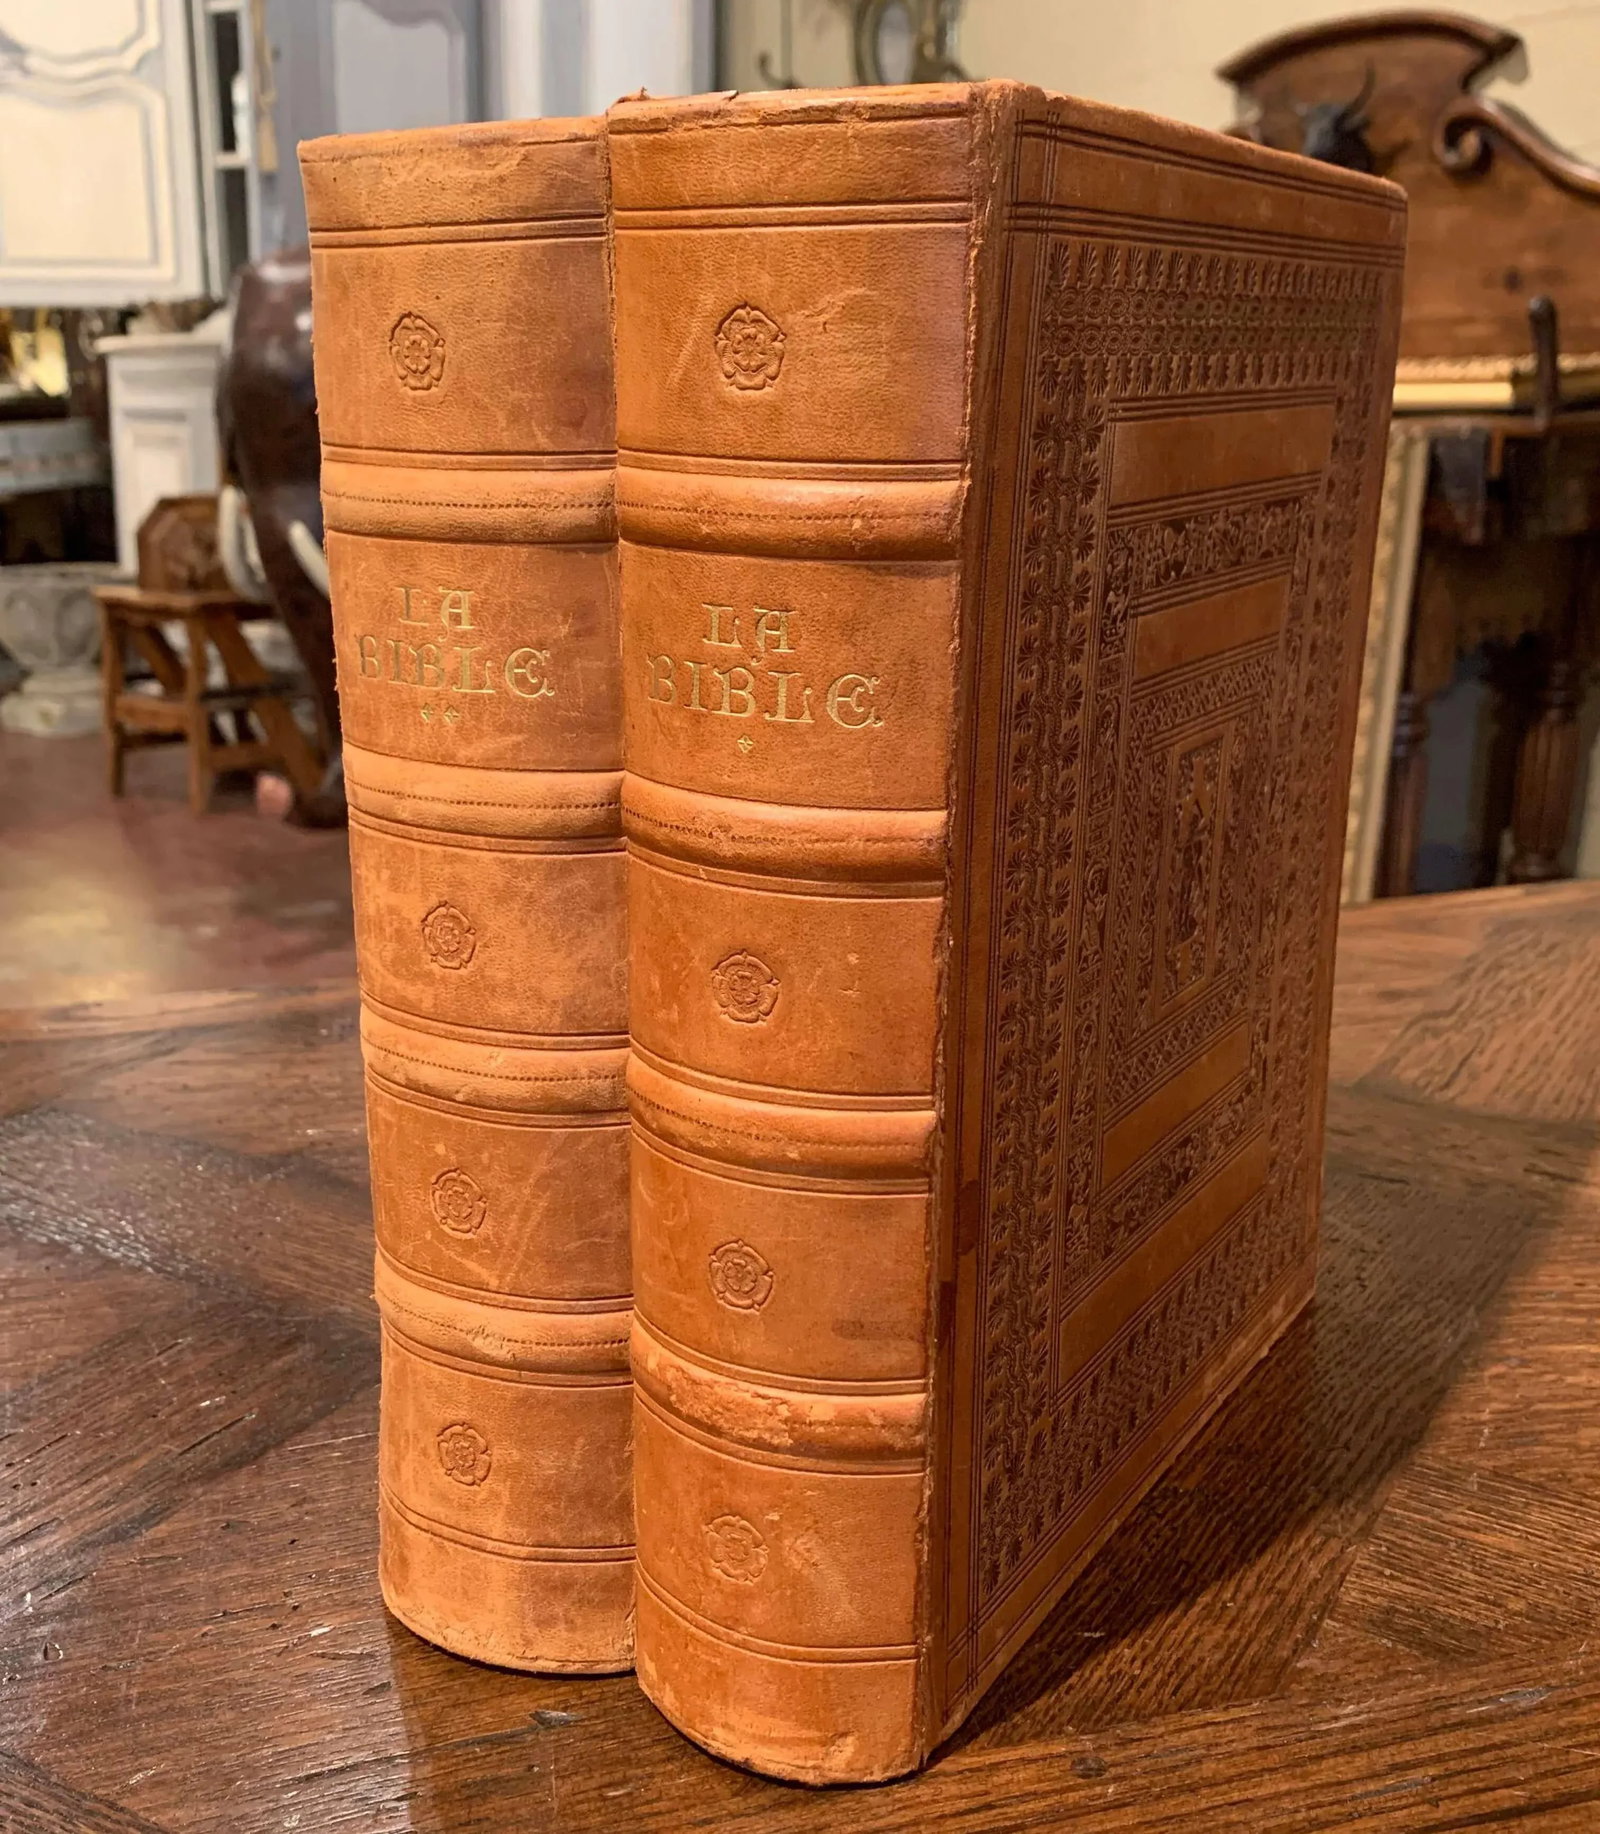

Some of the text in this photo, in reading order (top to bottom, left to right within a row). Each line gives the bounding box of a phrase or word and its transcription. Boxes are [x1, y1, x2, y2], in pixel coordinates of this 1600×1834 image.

[396, 586, 475, 642] LA
[701, 602, 797, 666] LA
[355, 634, 555, 698] BIBLE
[646, 653, 884, 729] BIBLE
